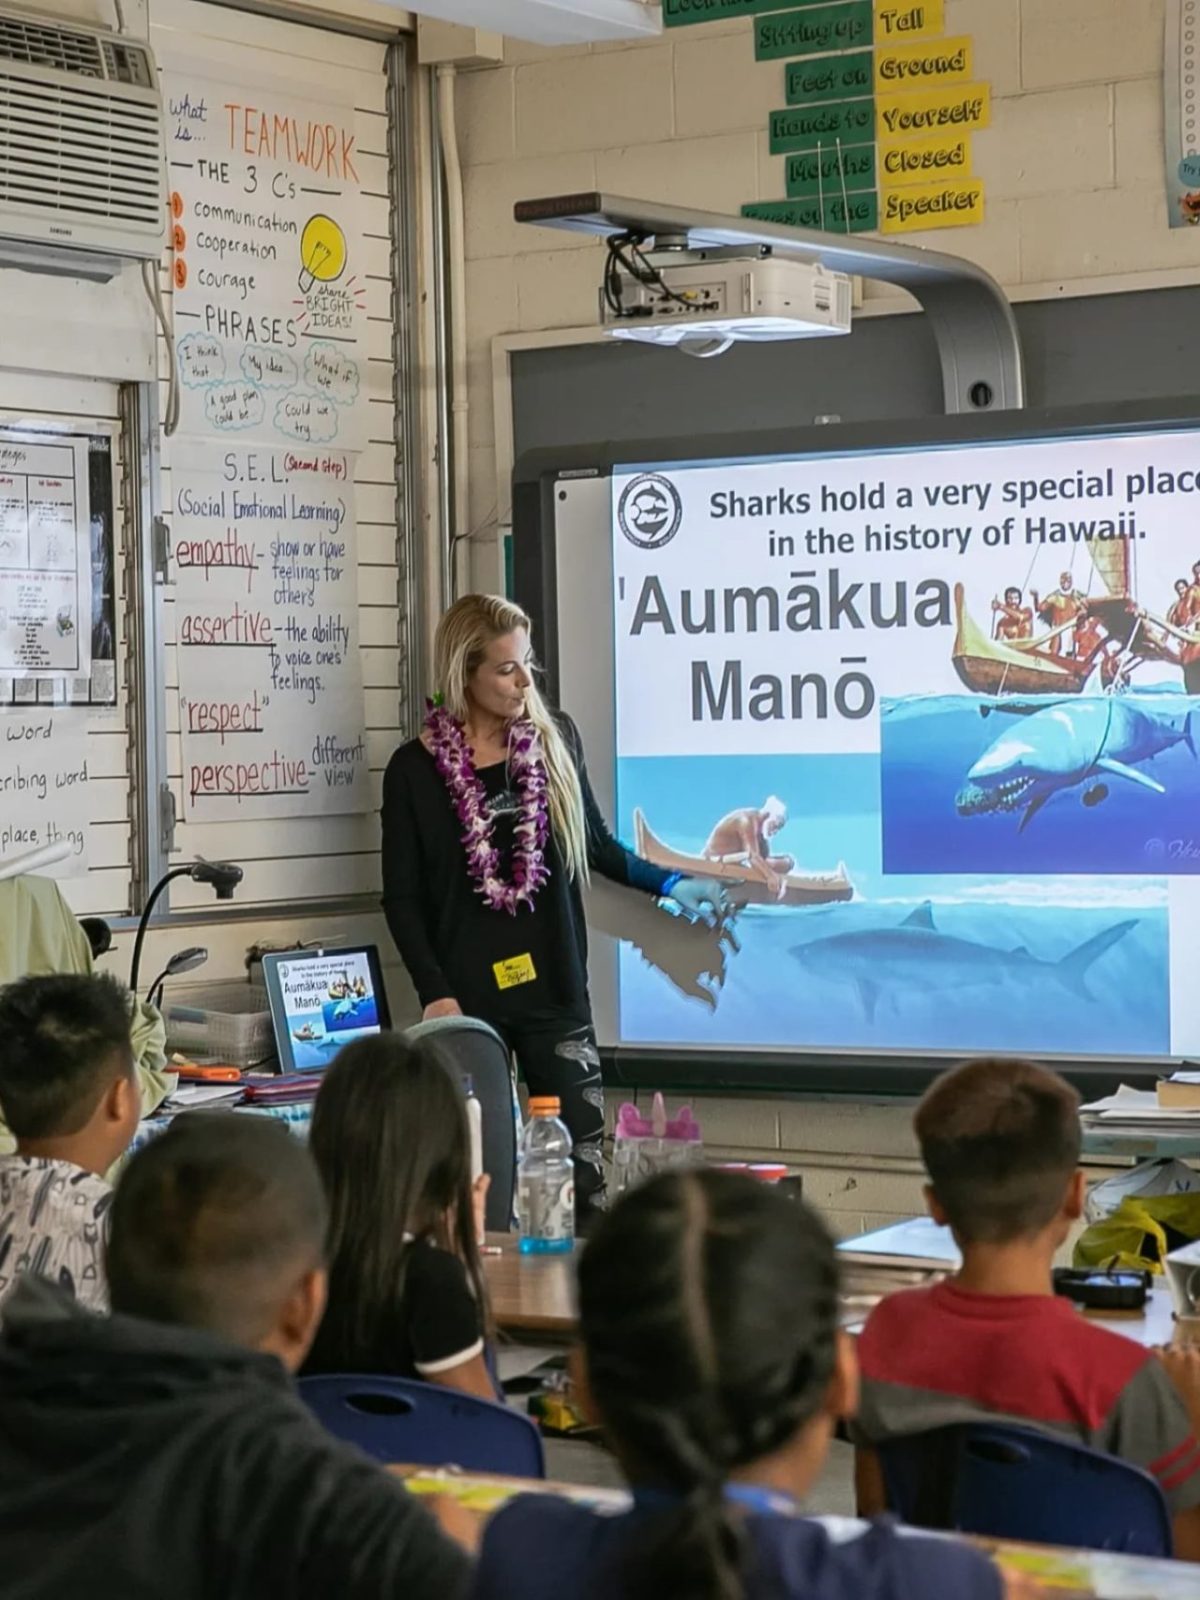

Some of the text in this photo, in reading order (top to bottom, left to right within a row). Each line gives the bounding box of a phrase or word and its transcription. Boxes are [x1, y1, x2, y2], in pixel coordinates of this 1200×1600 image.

[759, 19, 866, 48] Sitting up
[881, 8, 924, 34] Tall
[789, 64, 869, 95] Feet on
[879, 49, 967, 80] Ground
[773, 108, 871, 139] Hands to
[883, 98, 984, 132] Yourself
[225, 104, 360, 183] TEAMWORK
[884, 143, 965, 174] Closed
[198, 159, 296, 199] THE 3 C's
[789, 154, 872, 181] Mouths
[830, 201, 871, 223] the
[886, 189, 981, 222] Speaker
[306, 295, 354, 313] BRIGHT
[205, 304, 298, 348] PHRASES
[311, 313, 352, 329] IDEAS!
[183, 345, 218, 360] I think
[314, 352, 339, 375] What
[249, 355, 262, 382] My
[210, 395, 217, 406] A
[220, 389, 237, 410] good
[285, 403, 311, 417] Could
[295, 421, 311, 443] try
[710, 465, 1200, 520] Sharks hold a very special plac
[178, 488, 346, 535] (Social Emotional Learning)
[270, 531, 299, 558] show
[303, 545, 316, 557] or
[319, 532, 345, 559] have
[768, 511, 1146, 558] in the history of Hawaii.
[272, 553, 343, 592] feelings for
[285, 615, 308, 642] the
[312, 614, 350, 655] ability
[268, 646, 281, 669] to
[285, 650, 312, 666] voice
[691, 656, 876, 722] Manō
[7, 717, 53, 741] word
[312, 735, 366, 766] different
[0, 760, 88, 799] ribing word
[325, 766, 355, 788] view
[46, 821, 84, 855] thng
